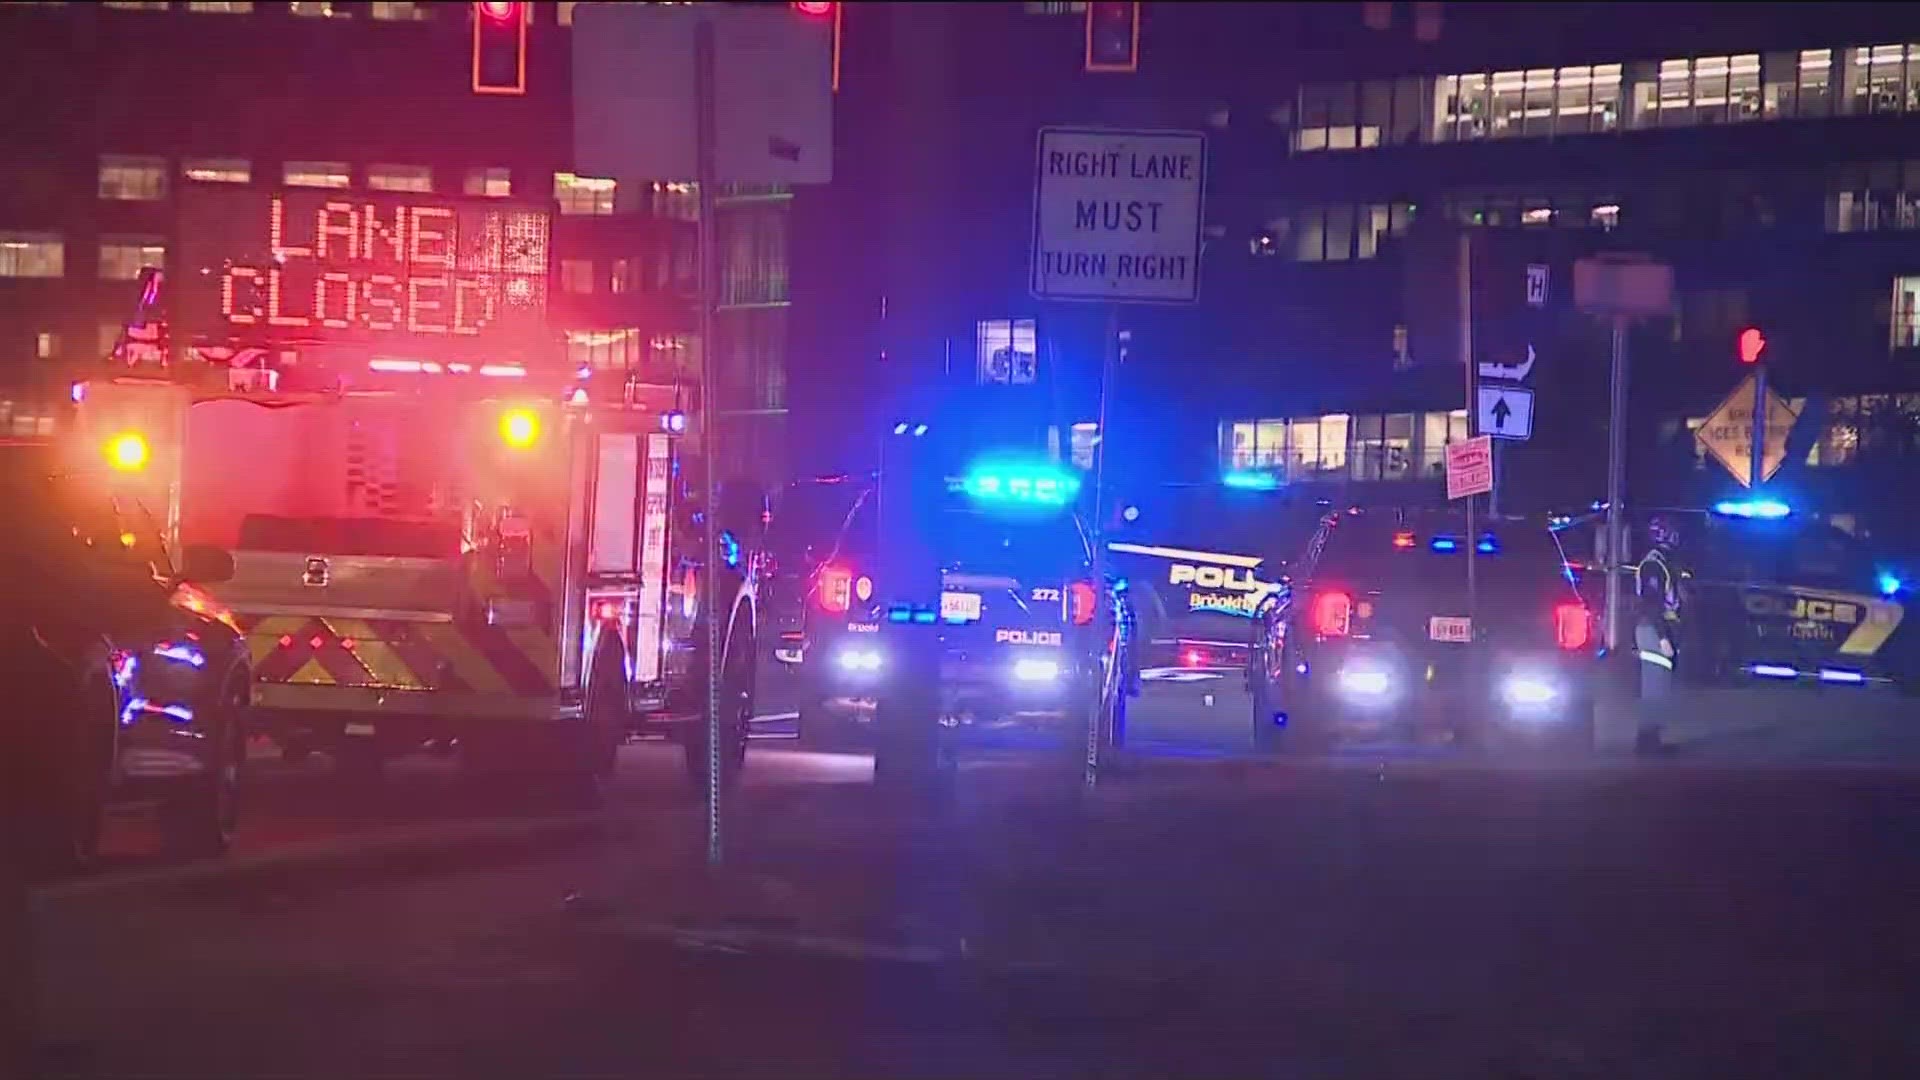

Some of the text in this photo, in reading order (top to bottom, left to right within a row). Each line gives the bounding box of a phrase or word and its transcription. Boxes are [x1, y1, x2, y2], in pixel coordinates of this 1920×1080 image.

[1049, 151, 1193, 180] RIGHT LANE
[270, 197, 453, 263] LANE
[1075, 200, 1164, 233] MUST
[1043, 251, 1190, 281] TURN RIGHT
[222, 267, 495, 336] CLOSED
[1169, 563, 1256, 590] POLI
[1031, 587, 1061, 602] 272
[995, 629, 1062, 646] POLICE
